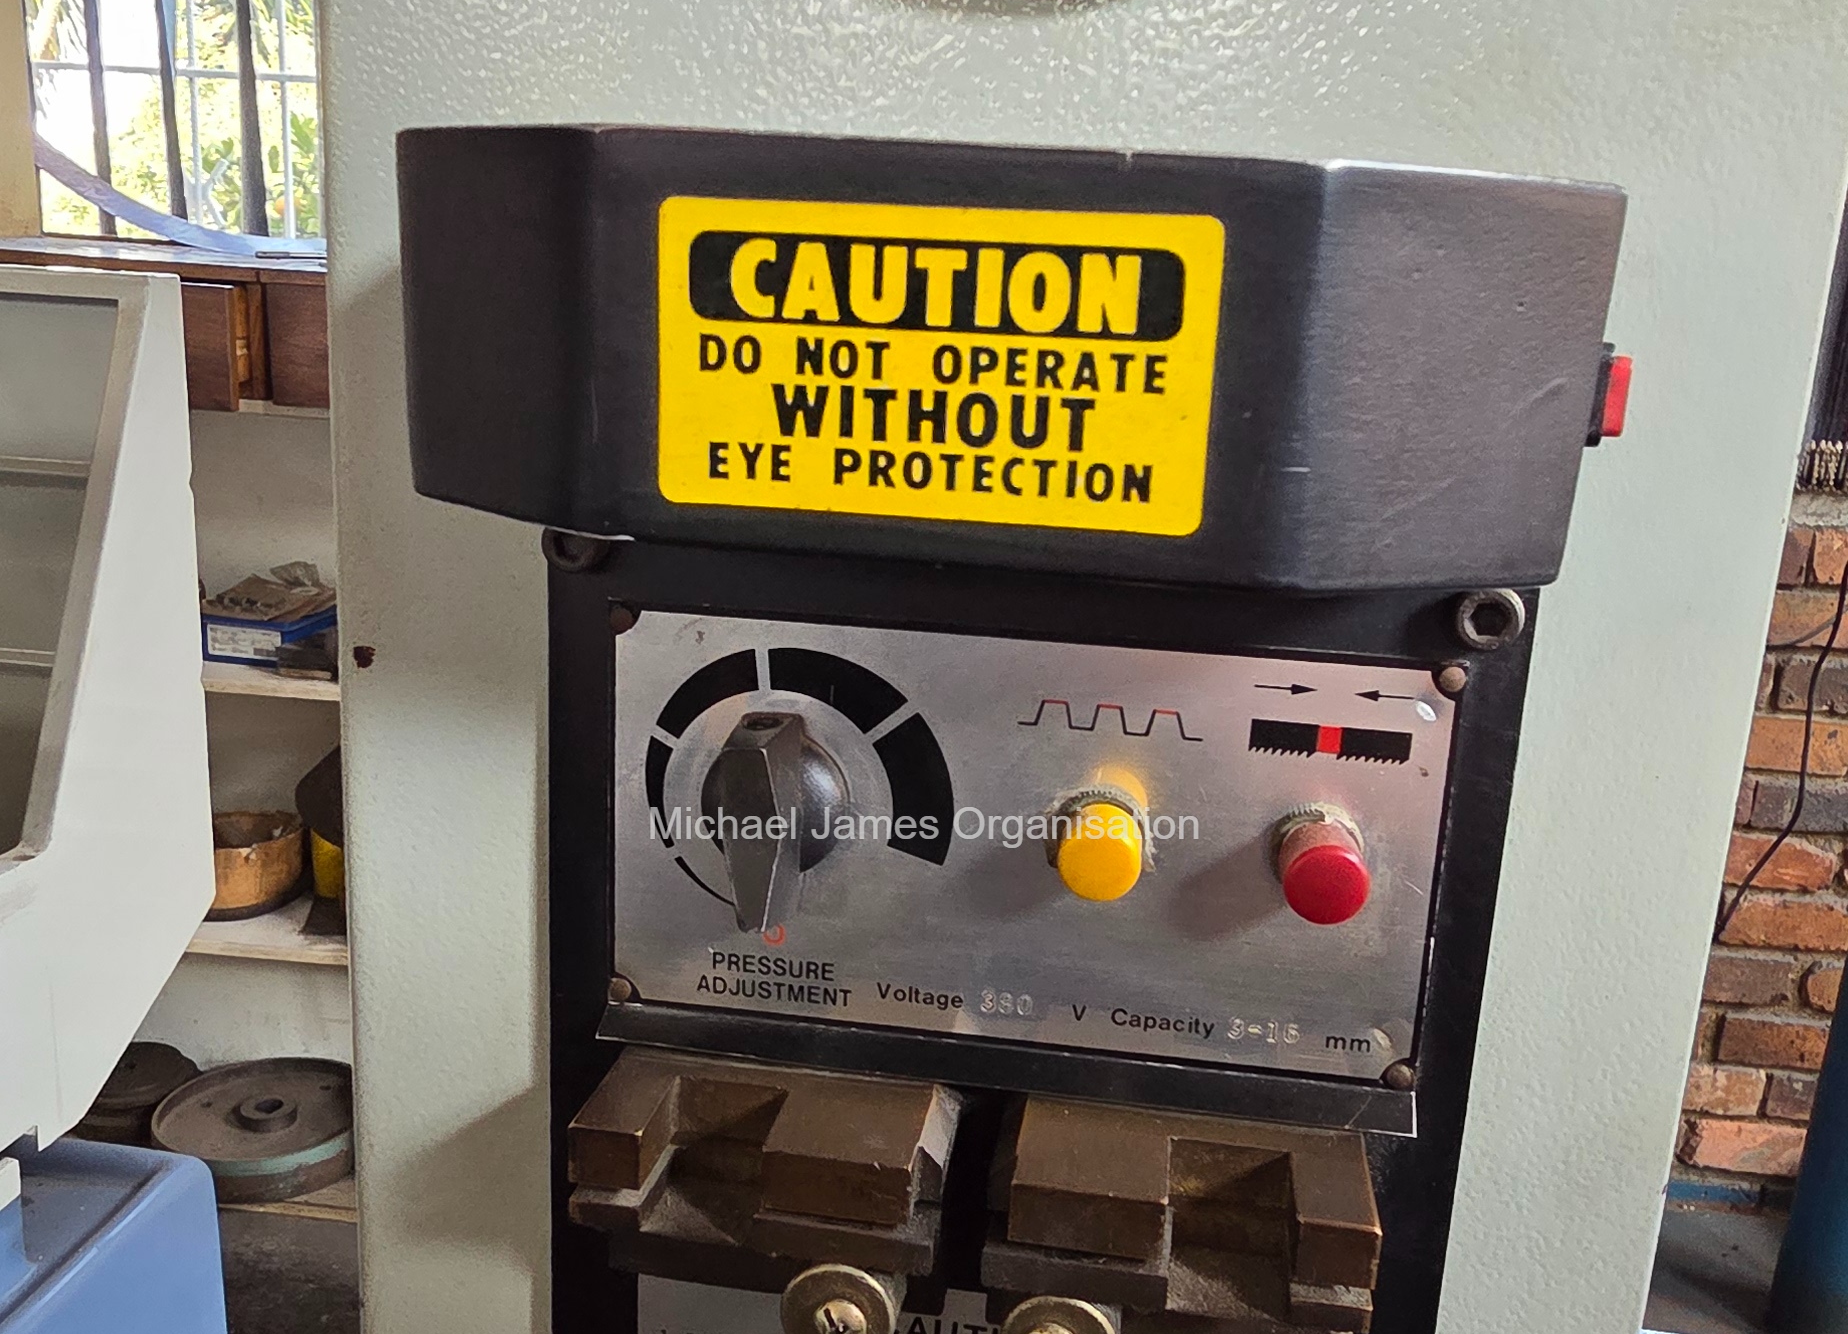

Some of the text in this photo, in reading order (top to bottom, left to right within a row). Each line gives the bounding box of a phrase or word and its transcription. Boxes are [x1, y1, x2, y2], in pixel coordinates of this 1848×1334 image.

[729, 237, 1143, 335] CAUTION
[699, 334, 1167, 395] DO NOT OPERATE
[771, 384, 1096, 452] WITHOUT
[708, 441, 1153, 504] EYE PROTECTION
[696, 974, 853, 1008] ADJUSTMENT
[711, 951, 836, 982] PRESSURE
[876, 981, 965, 1012] Voltage
[1072, 1004, 1087, 1022] V
[1110, 1007, 1216, 1040] Capacity
[1324, 1034, 1372, 1054] mm
